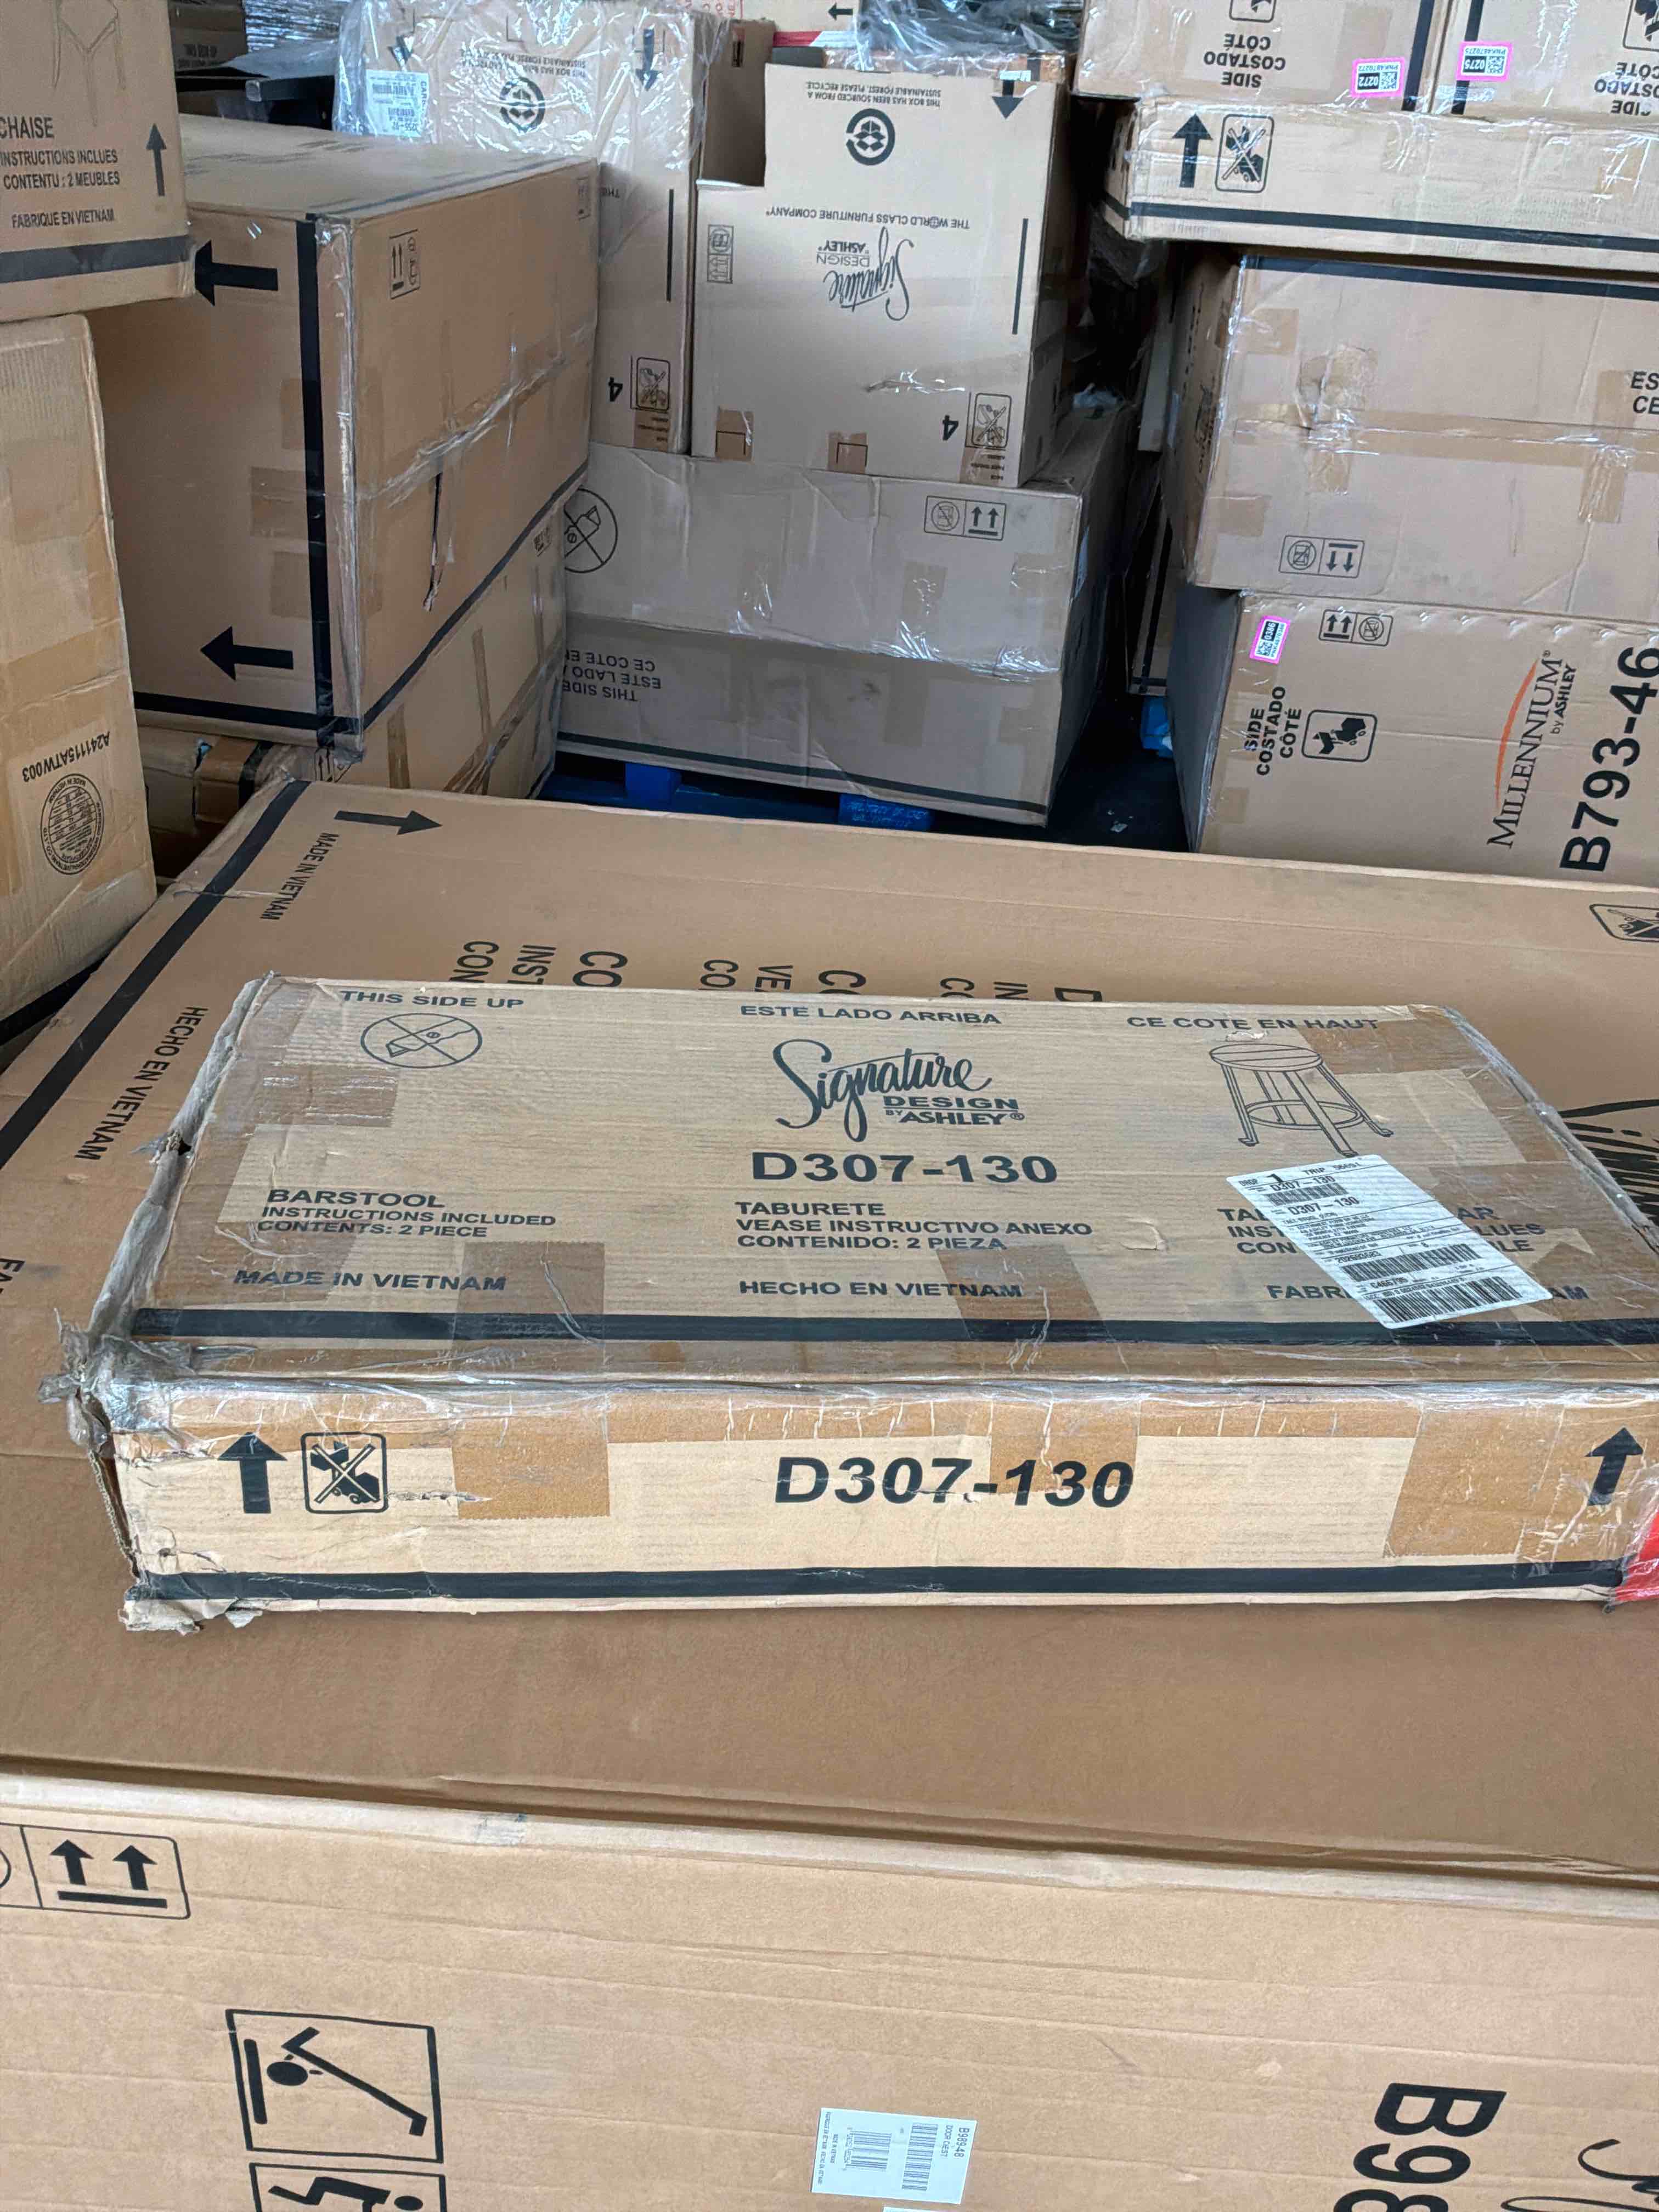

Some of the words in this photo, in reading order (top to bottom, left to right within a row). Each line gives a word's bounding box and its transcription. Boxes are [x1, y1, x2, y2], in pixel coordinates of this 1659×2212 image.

[1223, 33, 1271, 53] CÔTÉ
[1204, 52, 1286, 70] COSTADO
[1465, 59, 1485, 70] 0275
[556, 67, 571, 76] BOX
[1221, 71, 1262, 88] SIDE
[841, 84, 865, 93] PLEASE
[1359, 76, 1379, 87] 0272
[815, 92, 836, 101] FROM
[837, 93, 871, 103] SOURCED
[872, 95, 891, 104] BEEN
[893, 96, 907, 105] HAS
[895, 87, 941, 97] SUSTAINABLE
[909, 98, 924, 106] BOX
[927, 99, 940, 107] THIS
[0, 116, 54, 139] CHAISE
[0, 150, 75, 166] INSTRUCTIONS
[77, 149, 118, 164] INCLUES
[3, 173, 59, 190] CONTENTU
[67, 172, 74, 187] 2
[76, 171, 120, 187] MEUBLES
[11, 212, 60, 228] FABRIQUE
[61, 211, 74, 225] EN
[75, 208, 115, 224] VIETNAM
[819, 210, 874, 223] FURNITURE
[876, 214, 909, 225] CLASS
[950, 220, 970, 229] THE
[816, 254, 870, 267] DESIGN
[823, 226, 915, 321] Signature
[1631, 371, 1659, 390] ES
[608, 377, 623, 402] 4
[941, 415, 959, 441] 4
[1264, 622, 1276, 640] 0386
[585, 651, 629, 669] COTE
[633, 658, 656, 672] CE
[572, 666, 616, 683] LADO
[620, 673, 661, 690] ESTE
[562, 679, 597, 696] SIDE
[602, 686, 638, 702] THIS
[1553, 664, 1577, 719] ASHLEY
[1244, 708, 1265, 752] SIDE
[1256, 686, 1286, 776] COSTADO
[1279, 708, 1302, 759] CÔTÉ
[1549, 721, 1564, 735] by
[1559, 646, 1659, 872] B793-46
[303, 832, 340, 862] MADE
[294, 862, 320, 874] IN
[259, 876, 312, 920] VIETNAM
[448, 940, 499, 984] CON
[572, 951, 628, 988] CO
[341, 990, 404, 1004] THIS
[411, 995, 478, 1008] SIDE
[487, 997, 524, 1009] UP
[741, 1005, 810, 1018] ESTE
[818, 1008, 892, 1021] LADO
[900, 1010, 1002, 1025] ARRIBA
[1126, 1015, 1166, 1028] CE
[1172, 1017, 1248, 1030] COTE
[1258, 1018, 1298, 1030] EN
[1305, 1019, 1379, 1031] HAUT
[154, 1006, 209, 1057] HECHO
[133, 1060, 171, 1081] EN
[772, 1039, 993, 1142] Signature
[883, 1096, 1019, 1110] DESIGN
[74, 1086, 153, 1160] VIETNAM
[752, 1152, 1058, 1184] D307-130
[1266, 1173, 1285, 1183] 1
[1302, 1167, 1325, 1176] TRIP
[267, 1189, 445, 1208] BARSTOOL
[262, 1206, 435, 1222] INSTRUCTIONS
[441, 1212, 556, 1226] INCLUDED
[735, 1202, 886, 1216] TABURETE
[258, 1220, 392, 1235] CONTENTS:
[398, 1224, 413, 1236] 2
[418, 1225, 488, 1238] PIECE
[737, 1220, 822, 1232] VEASE
[830, 1220, 1000, 1234] INSTRUCTIVO
[1005, 1222, 1093, 1236] ANEXO
[737, 1235, 899, 1250] CONTENIDO:
[907, 1237, 921, 1249] 2
[928, 1238, 1007, 1251] PIEZA
[234, 1269, 325, 1285] MADE
[332, 1272, 363, 1286] IN
[373, 1273, 507, 1291] VIETNAM
[740, 1281, 840, 1295] HECHO
[850, 1282, 888, 1296] EN
[895, 1282, 1023, 1298] VIETNAM
[776, 1456, 1133, 1508] D307-130
[944, 2124, 953, 2140] DOOR
[940, 2141, 950, 2157] CHEST
